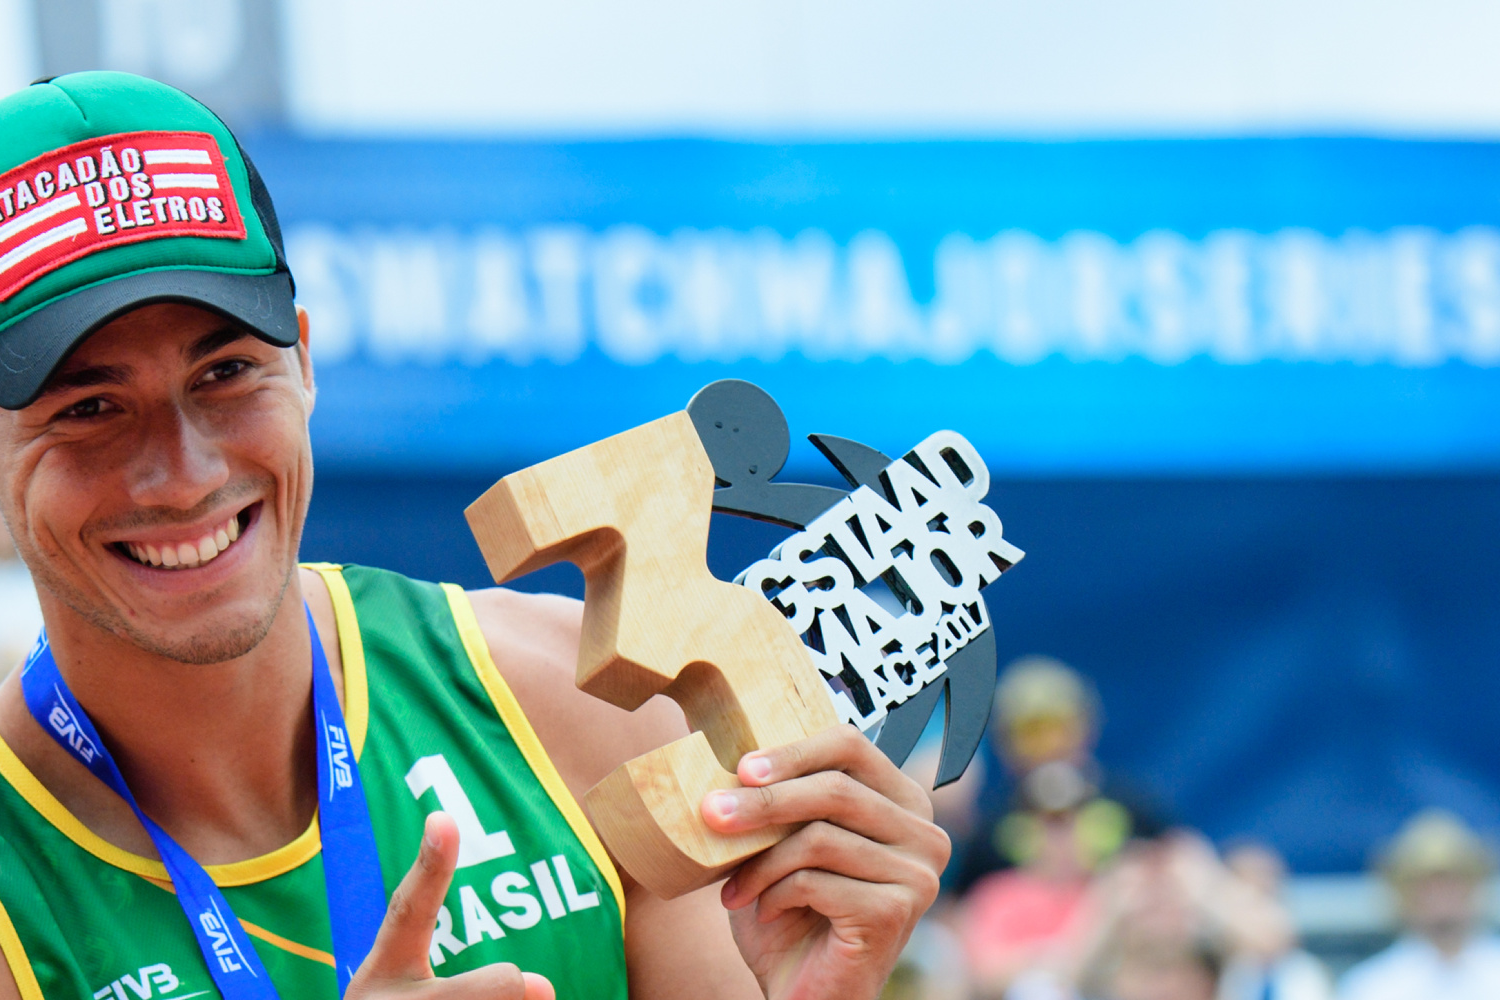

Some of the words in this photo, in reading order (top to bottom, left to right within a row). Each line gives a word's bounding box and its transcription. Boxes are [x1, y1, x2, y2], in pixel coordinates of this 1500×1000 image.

[85, 173, 153, 208] DOS
[93, 195, 228, 236] ELETROS
[740, 429, 991, 636] GSTAAD
[800, 502, 1026, 716] MAJOR
[835, 643, 949, 732] LACE
[927, 600, 991, 662] 2017
[48, 706, 94, 763] FIVB
[328, 724, 353, 788] FIVB
[404, 753, 516, 869] 1
[199, 911, 242, 974] FIVB
[429, 853, 600, 967] RASIL
